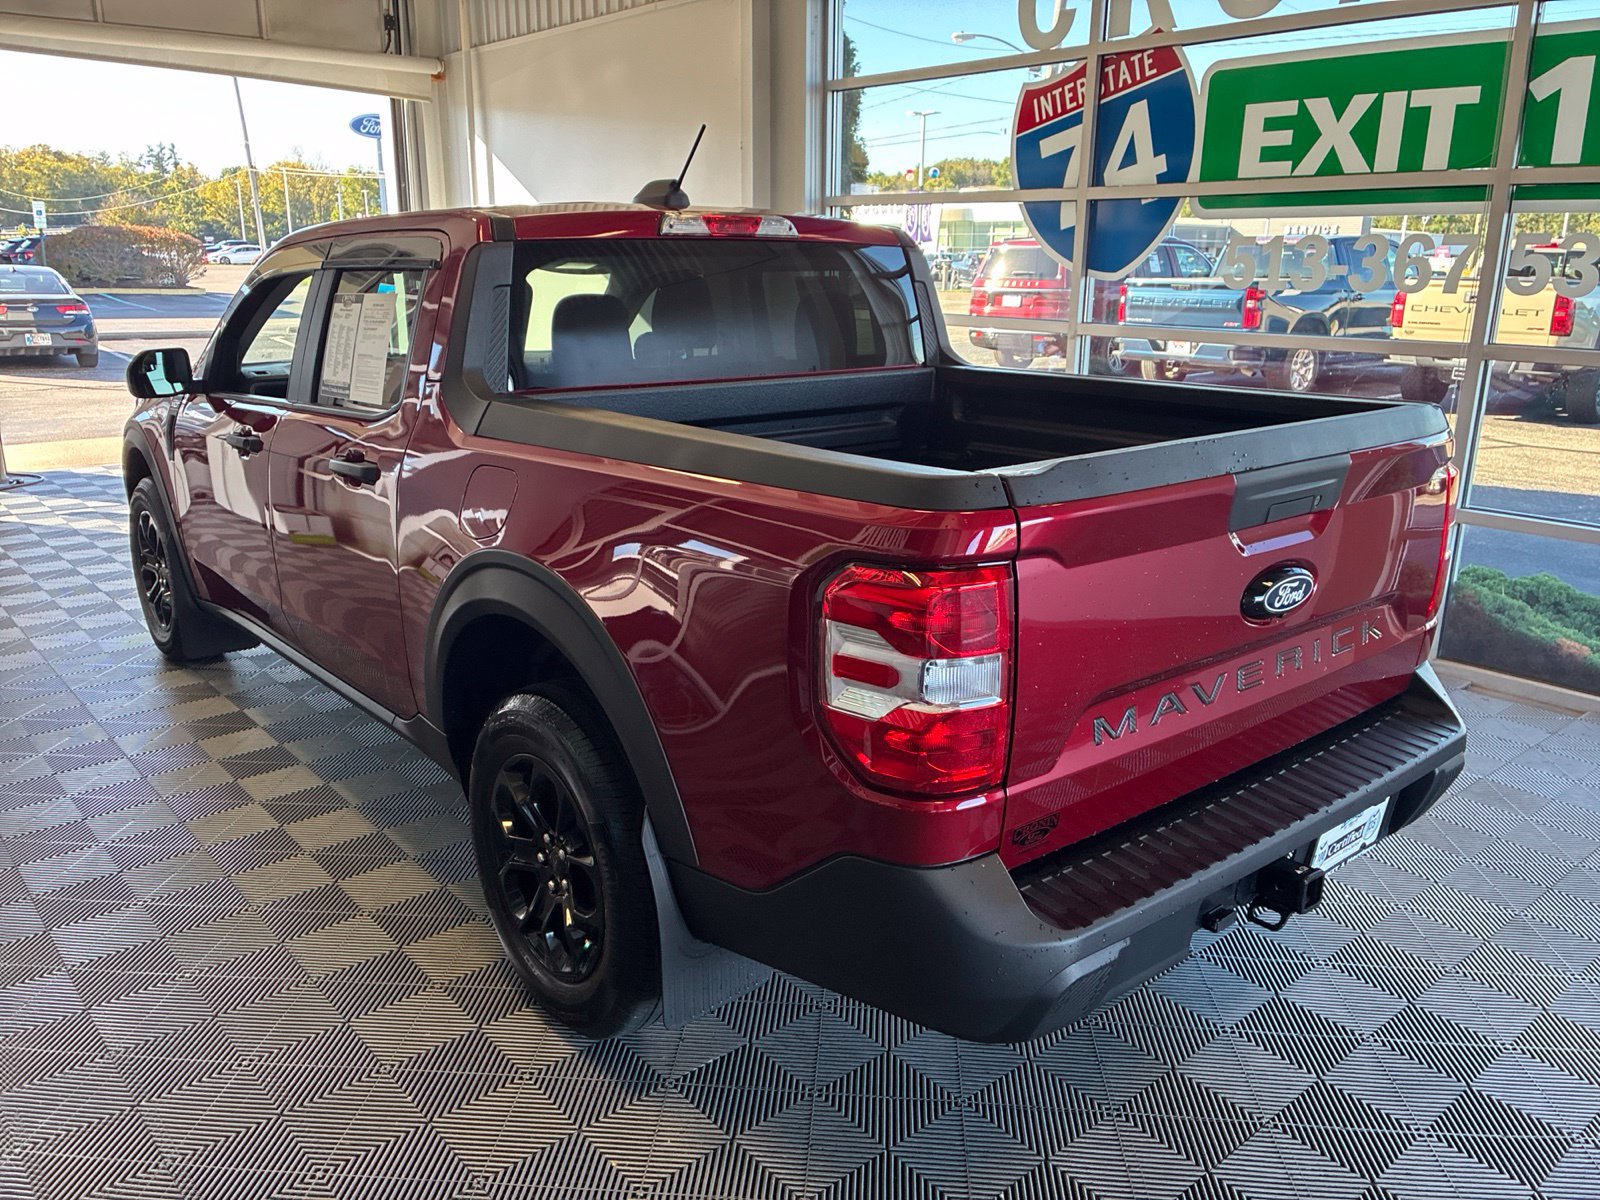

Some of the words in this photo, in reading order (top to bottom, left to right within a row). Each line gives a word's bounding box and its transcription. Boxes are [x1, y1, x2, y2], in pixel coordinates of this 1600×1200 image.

[1033, 49, 1158, 123] INTERTATE
[360, 117, 381, 133] For
[1237, 85, 1482, 179] EXIT
[1529, 54, 1597, 165] 1
[1039, 99, 1167, 230] 74
[1283, 224, 1340, 236] SERVICE
[1129, 295, 1238, 309] CHEVROLET
[1411, 304, 1544, 317] CHEVLET
[1274, 581, 1307, 608] Ford
[1093, 615, 1382, 746] MAVERICK
[1327, 825, 1365, 857] Certified
